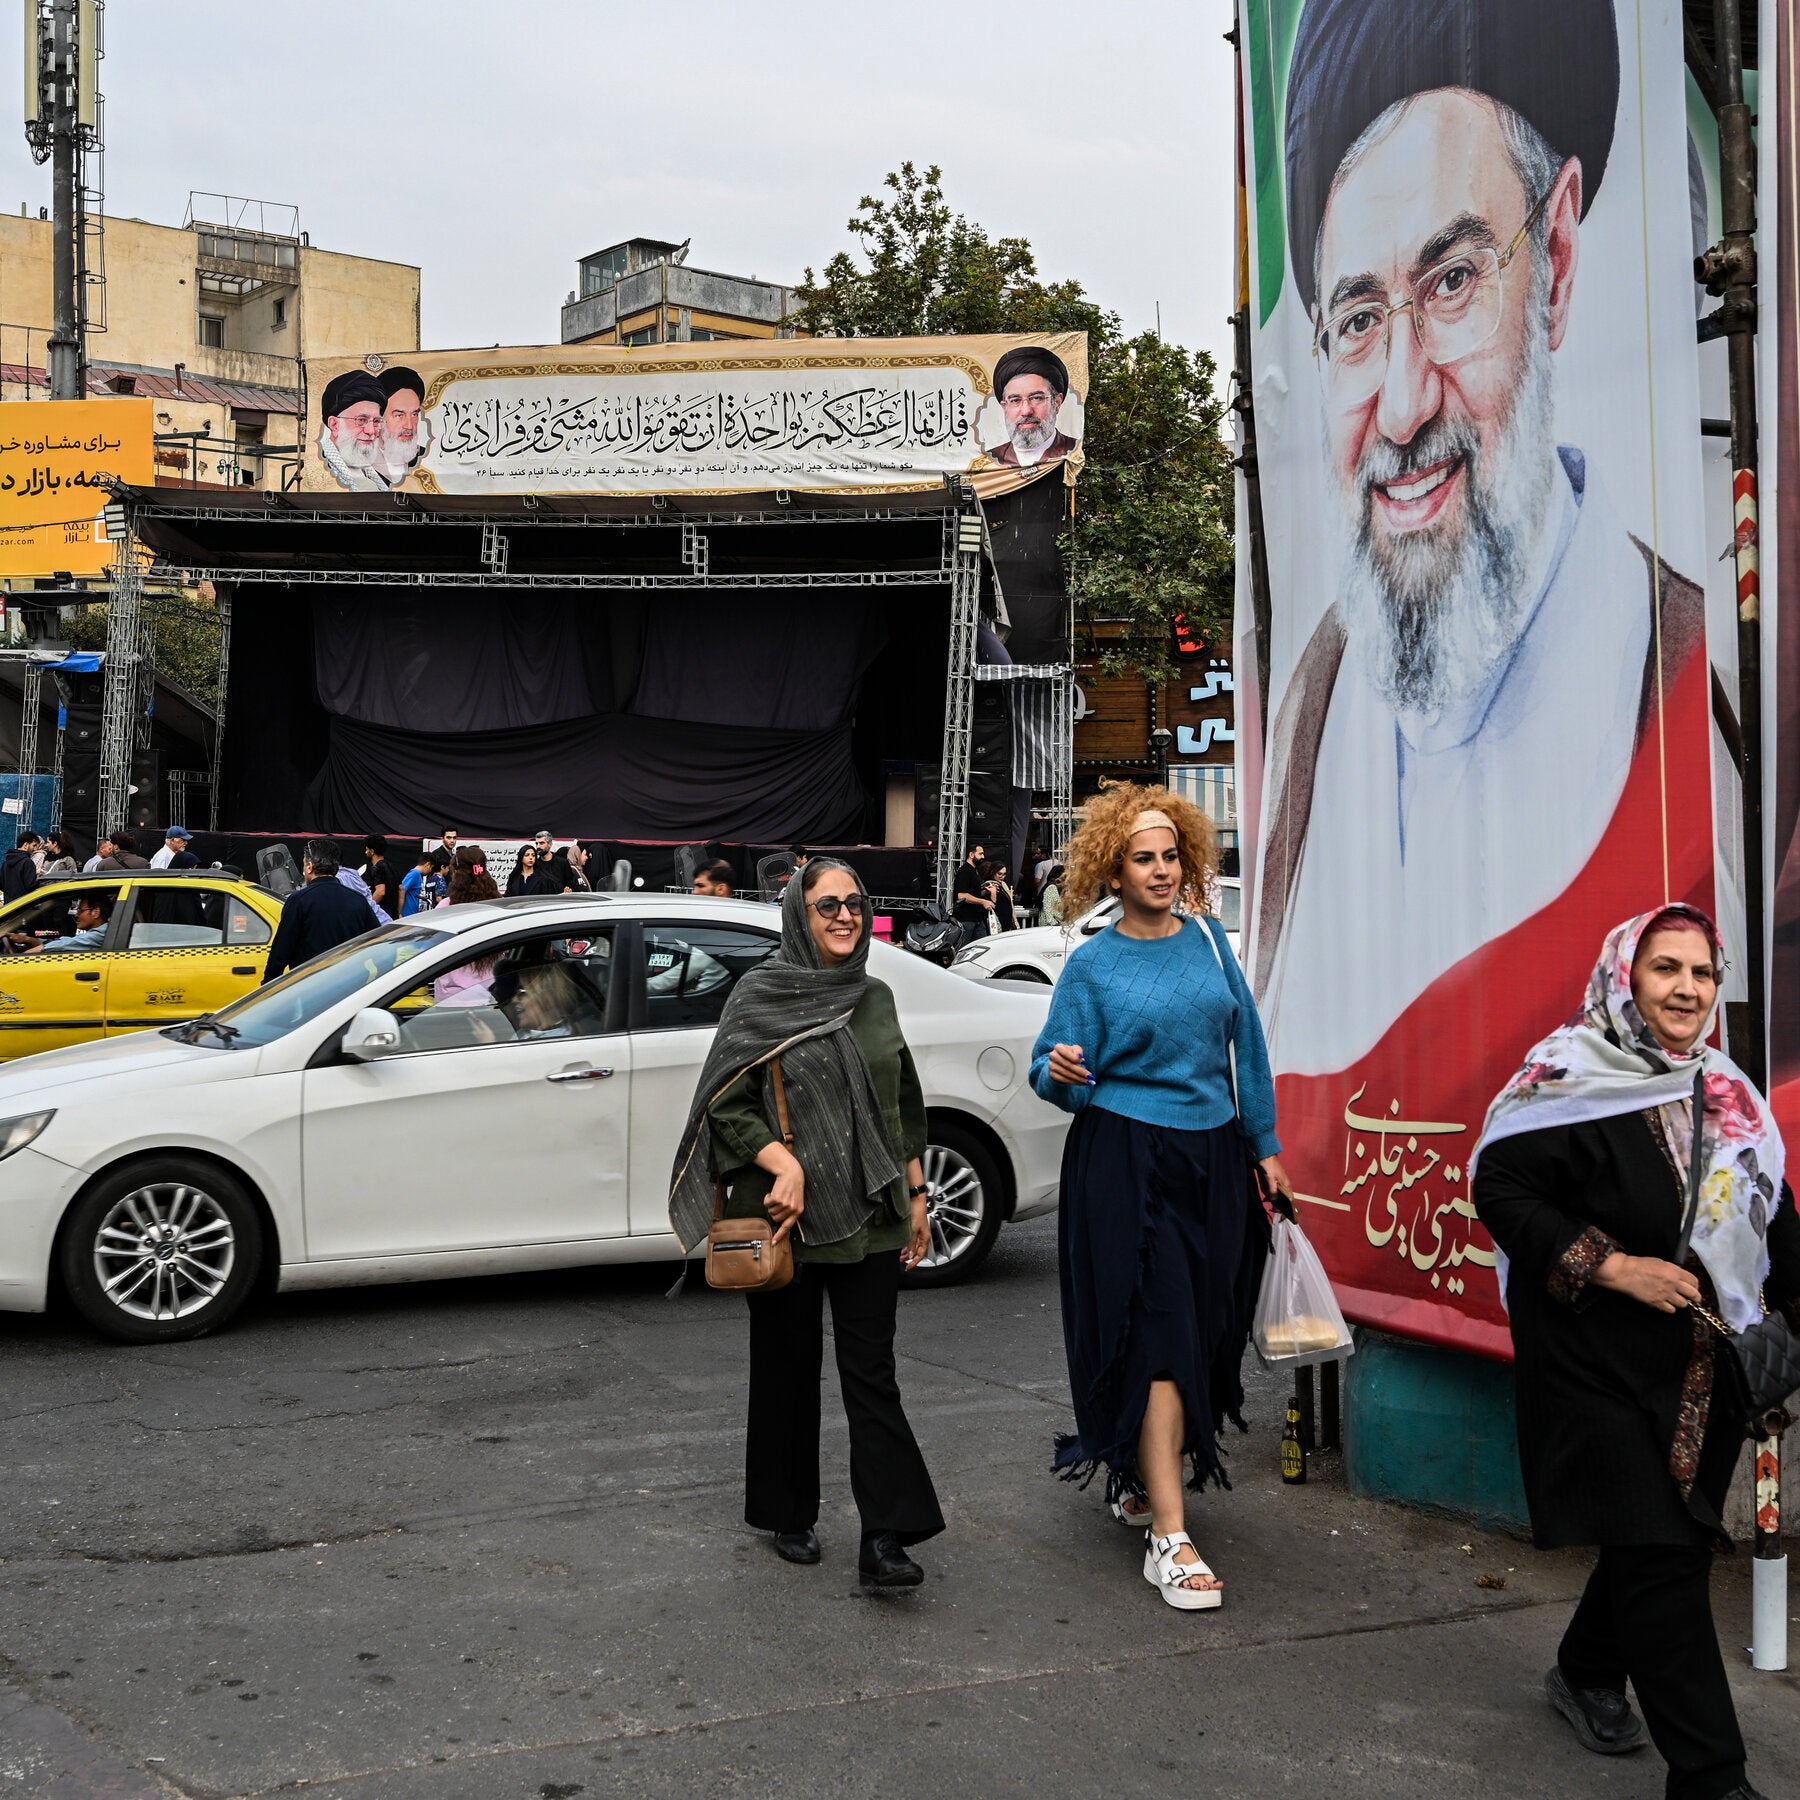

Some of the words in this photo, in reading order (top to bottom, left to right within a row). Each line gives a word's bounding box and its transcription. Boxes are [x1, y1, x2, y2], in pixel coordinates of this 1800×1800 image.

[24, 435, 80, 454] مشاوره
[84, 434, 121, 453] برای
[642, 466, 649, 476] یا
[651, 465, 664, 476] نفر
[666, 466, 676, 475] دو
[695, 466, 705, 475] دو
[730, 462, 740, 473] آن
[742, 465, 748, 473] و
[807, 462, 822, 473] چیز
[840, 463, 849, 473] به
[851, 462, 868, 472] تنها
[869, 462, 878, 472] را
[879, 462, 896, 470] شما
[528, 467, 544, 478] قیام
[546, 467, 559, 476] خدا
[562, 467, 581, 477] برای
[583, 466, 596, 477] نفر
[612, 466, 625, 477] نفر
[17, 467, 60, 496] بازار
